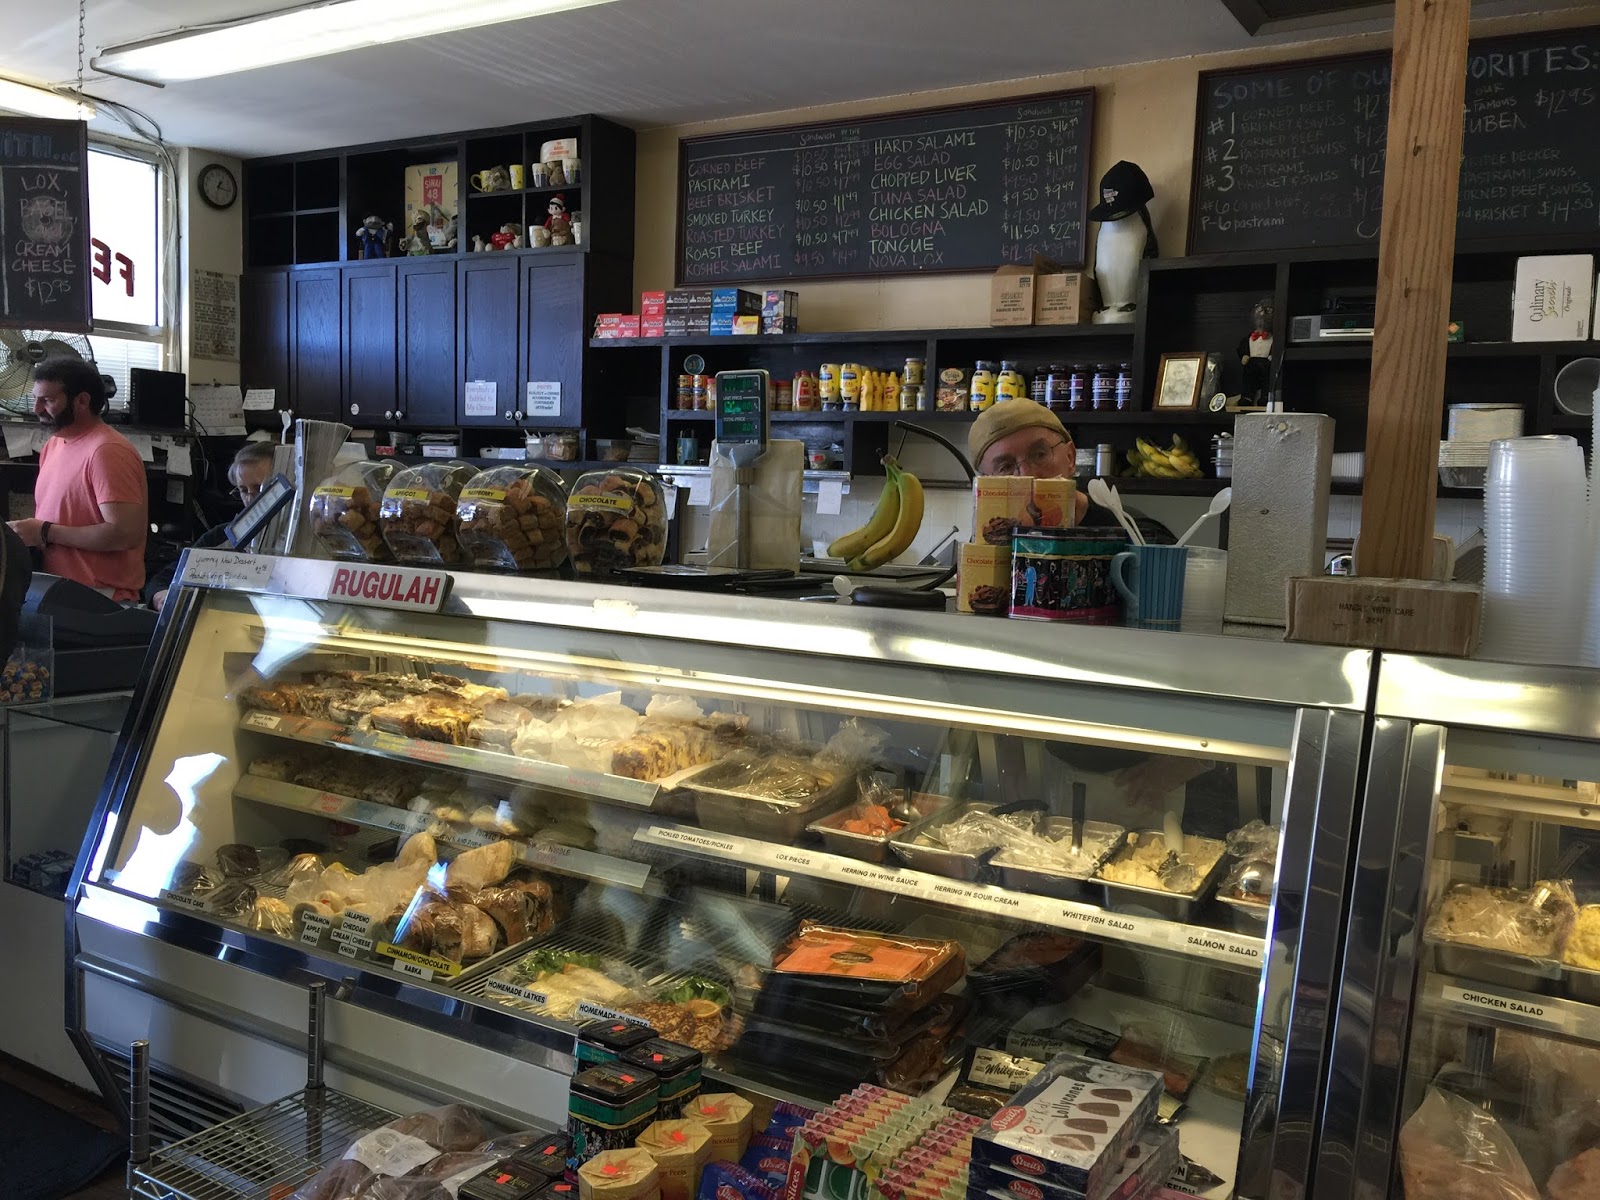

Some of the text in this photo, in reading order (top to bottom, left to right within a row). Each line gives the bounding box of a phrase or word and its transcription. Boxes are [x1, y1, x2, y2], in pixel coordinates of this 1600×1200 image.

[1213, 78, 1294, 109] SOME
[1469, 44, 1600, 79] ORITES:
[1241, 105, 1295, 122] CORNED
[1299, 99, 1335, 113] BEEF
[1473, 97, 1518, 112] FAMOUS
[1241, 113, 1347, 134] BRISKET SWISS
[874, 138, 913, 155] HARD
[917, 132, 976, 151] SALAMI
[1240, 135, 1286, 148] CORNED
[874, 151, 951, 172] EGG SALAD
[1240, 147, 1301, 161] PASTRAMI
[1512, 147, 1561, 163] DECKER
[688, 161, 730, 177] CORNED
[734, 157, 766, 173] BEEF
[21, 172, 68, 198] LOX,
[424, 179, 442, 189] SINAI
[688, 174, 751, 194] PASTRAMI
[871, 170, 930, 190] CHOPPED
[935, 164, 977, 185] LIVER
[1301, 170, 1339, 185] SWISS
[426, 189, 439, 200] 48
[687, 186, 775, 212] BEEF BRISKET
[871, 189, 912, 206] TUNA
[917, 184, 967, 202] SALAD
[1463, 186, 1508, 201] ORNED
[19, 198, 78, 225] BAGEL,
[687, 212, 728, 227] SMOKED
[732, 208, 775, 224] TURKEY
[869, 203, 935, 222] CHICKEN
[940, 199, 989, 219] SALAD
[1457, 207, 1472, 219] nd
[1474, 204, 1534, 222] BRISKET
[871, 220, 947, 238] BOLOGNA
[1234, 212, 1285, 231] pastrami
[687, 228, 735, 245] ROASTED
[738, 224, 785, 241] TURKEY
[15, 239, 71, 258] CREAM
[686, 245, 724, 261] ROAST
[730, 240, 764, 256] BEEF
[869, 236, 934, 255] TONGUE
[12, 258, 77, 275] CHEESE
[686, 261, 730, 277] KOSHER
[732, 254, 782, 273] SALAMI
[869, 252, 944, 269] NOVA LOX
[1529, 279, 1549, 322] Culinary
[578, 496, 618, 506] CHOCOLATE
[982, 489, 1009, 497] Chocolate
[966, 557, 993, 565] Chocolate
[331, 567, 441, 606] RUGULAH
[1371, 605, 1415, 617] WITH CARE
[658, 830, 734, 851] PICKLED TOMATOES/PICKLES
[776, 852, 810, 865] LOX PIECES
[841, 866, 919, 887] HERRING IN WINE SAUCE
[166, 892, 205, 908] CHOCOLATE CAKE
[933, 884, 1020, 907] HERRING IN SOUR CREAM
[303, 912, 331, 926] CINNAMON
[344, 909, 371, 924] JALAPENO
[1062, 909, 1135, 932] WHITEFISH SALAD
[305, 924, 321, 934] APPLE
[342, 921, 367, 935] CHEDDAR
[302, 933, 318, 944] KNISH
[332, 930, 372, 949] CREAM CHEESE
[1187, 935, 1259, 958] SALMON SALAD
[340, 945, 356, 956] KNISH
[386, 946, 451, 972] CINNAMON/CHOCOLATE
[403, 964, 423, 976] BABKA
[488, 980, 546, 1004] HOMEMADE LATKES
[579, 1003, 617, 1020] HOMEMADE
[1462, 992, 1544, 1017] CHICKEN SALAD
